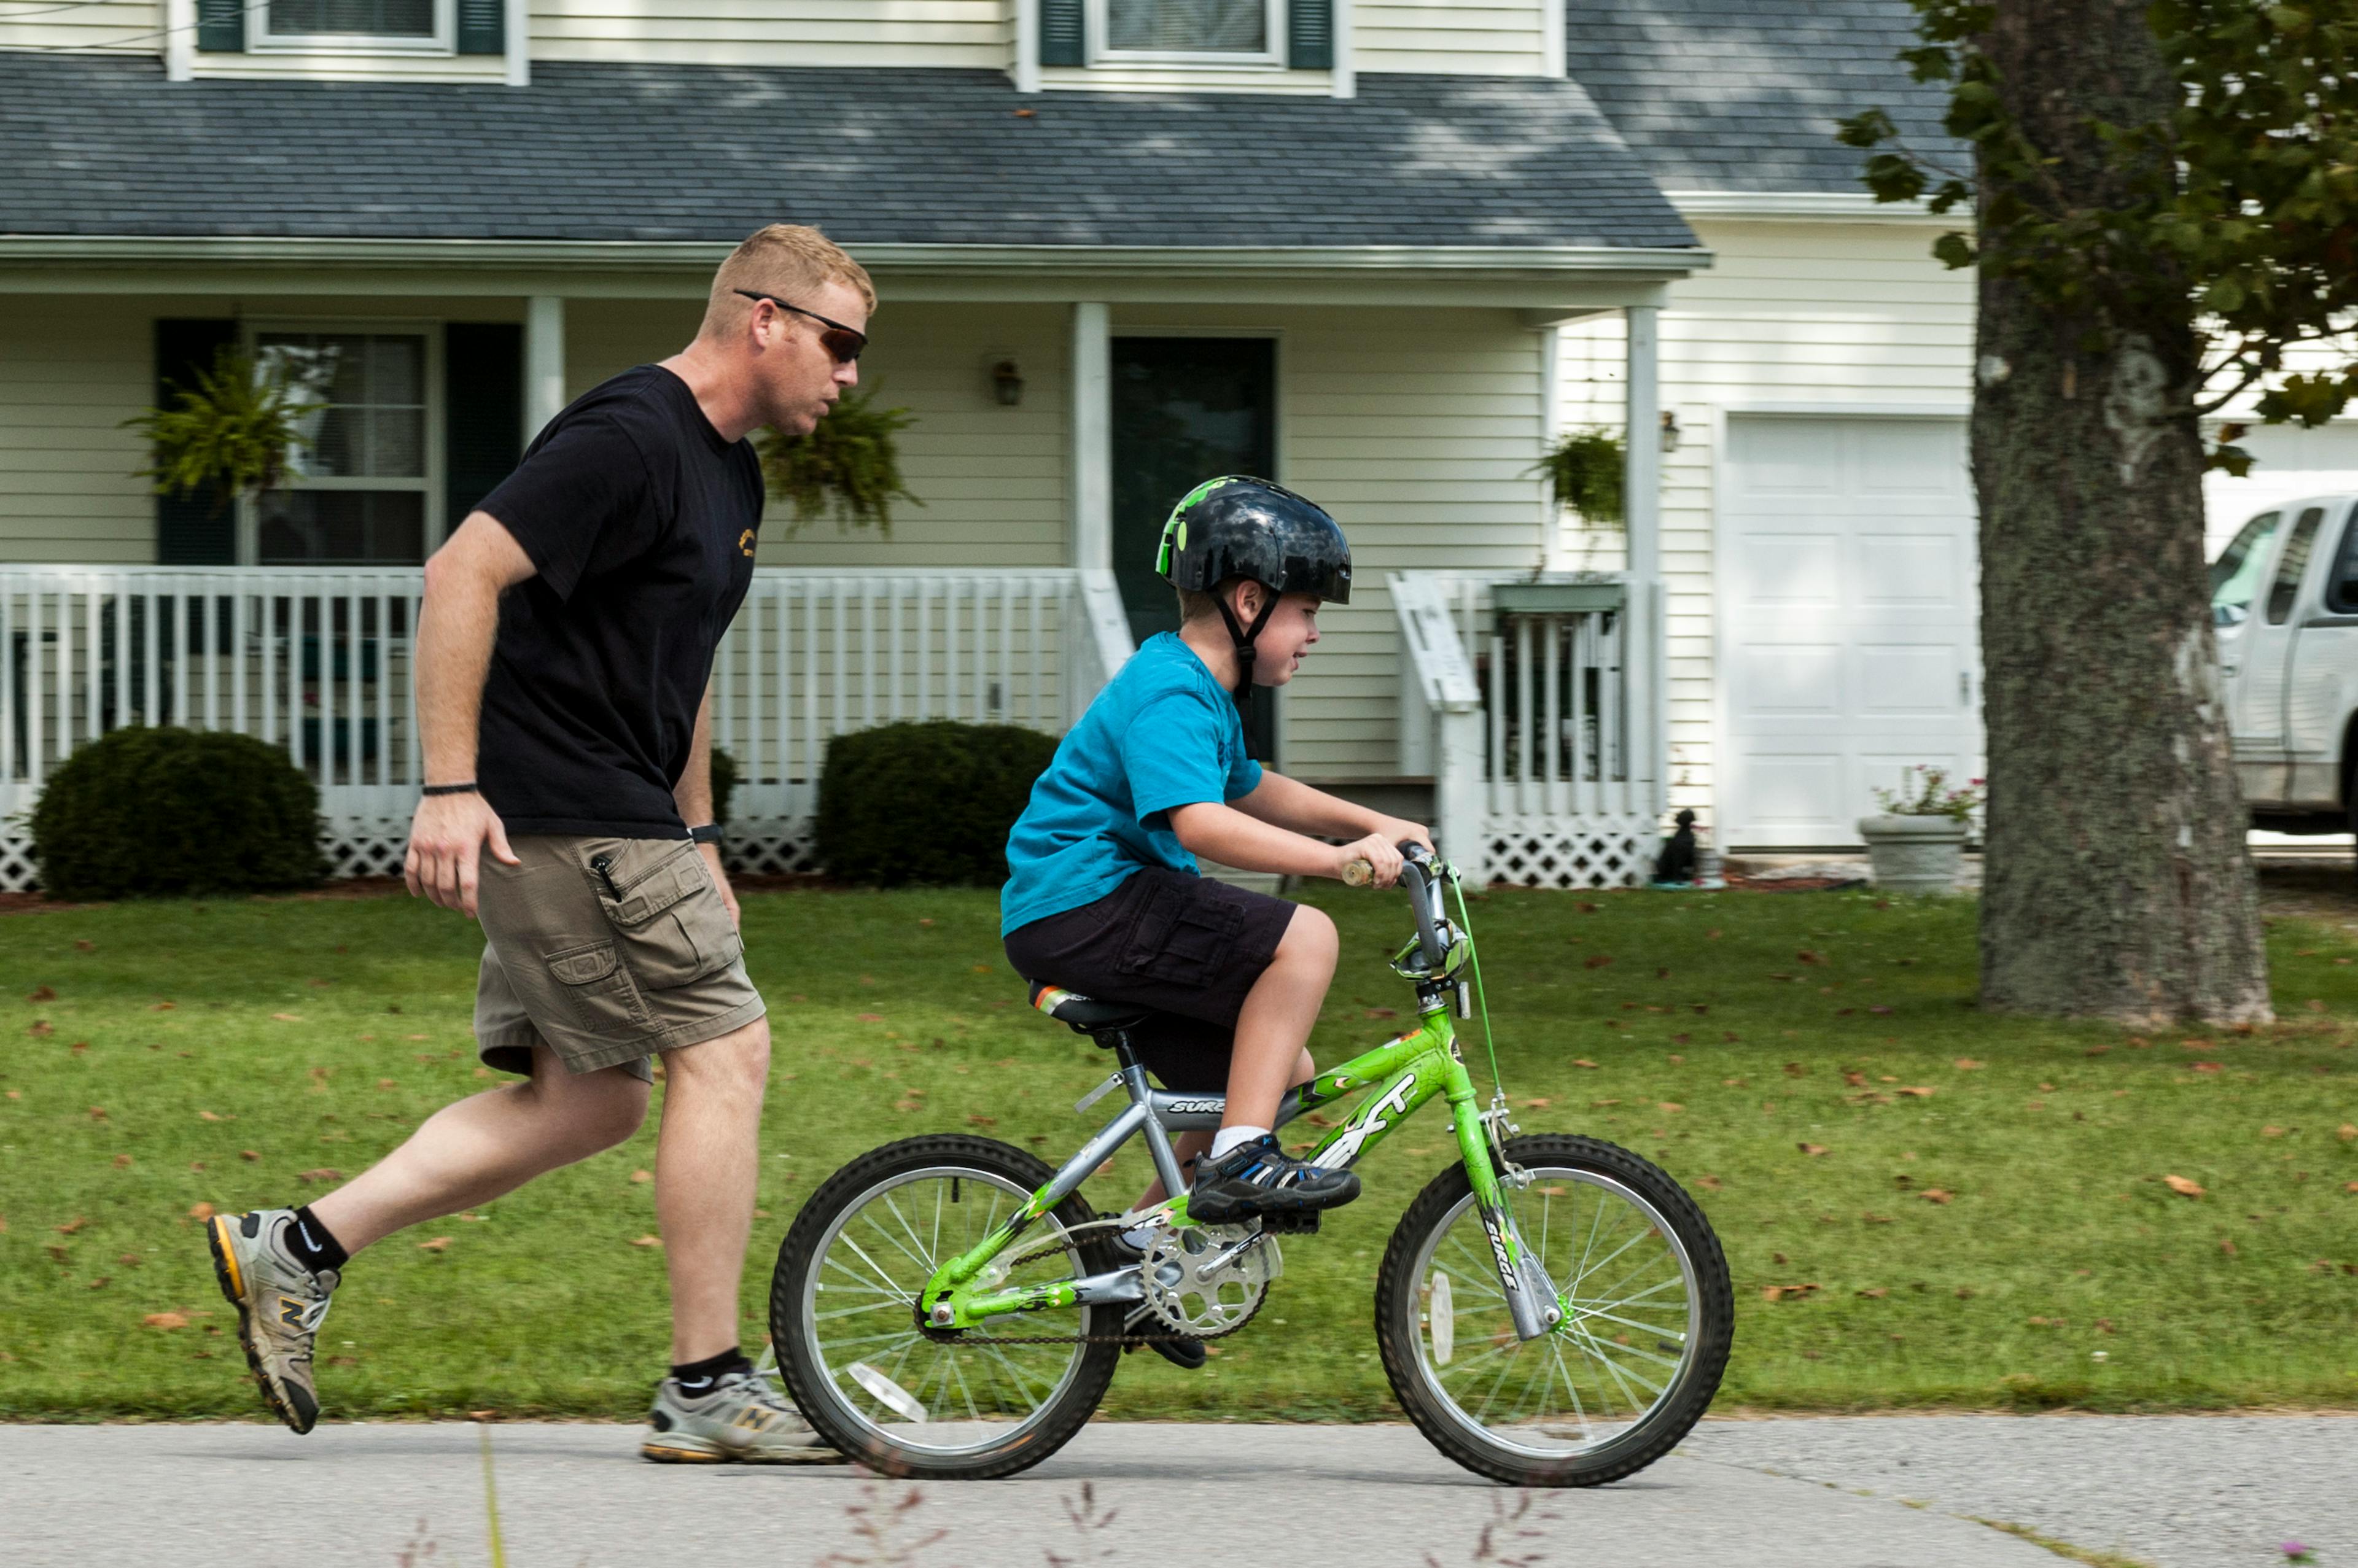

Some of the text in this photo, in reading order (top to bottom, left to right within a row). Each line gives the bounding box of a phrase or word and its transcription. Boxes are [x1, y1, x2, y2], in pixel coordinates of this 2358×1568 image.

[1484, 1219, 1519, 1291] SURGE
[279, 1296, 306, 1330] N
[733, 1405, 776, 1433] N
